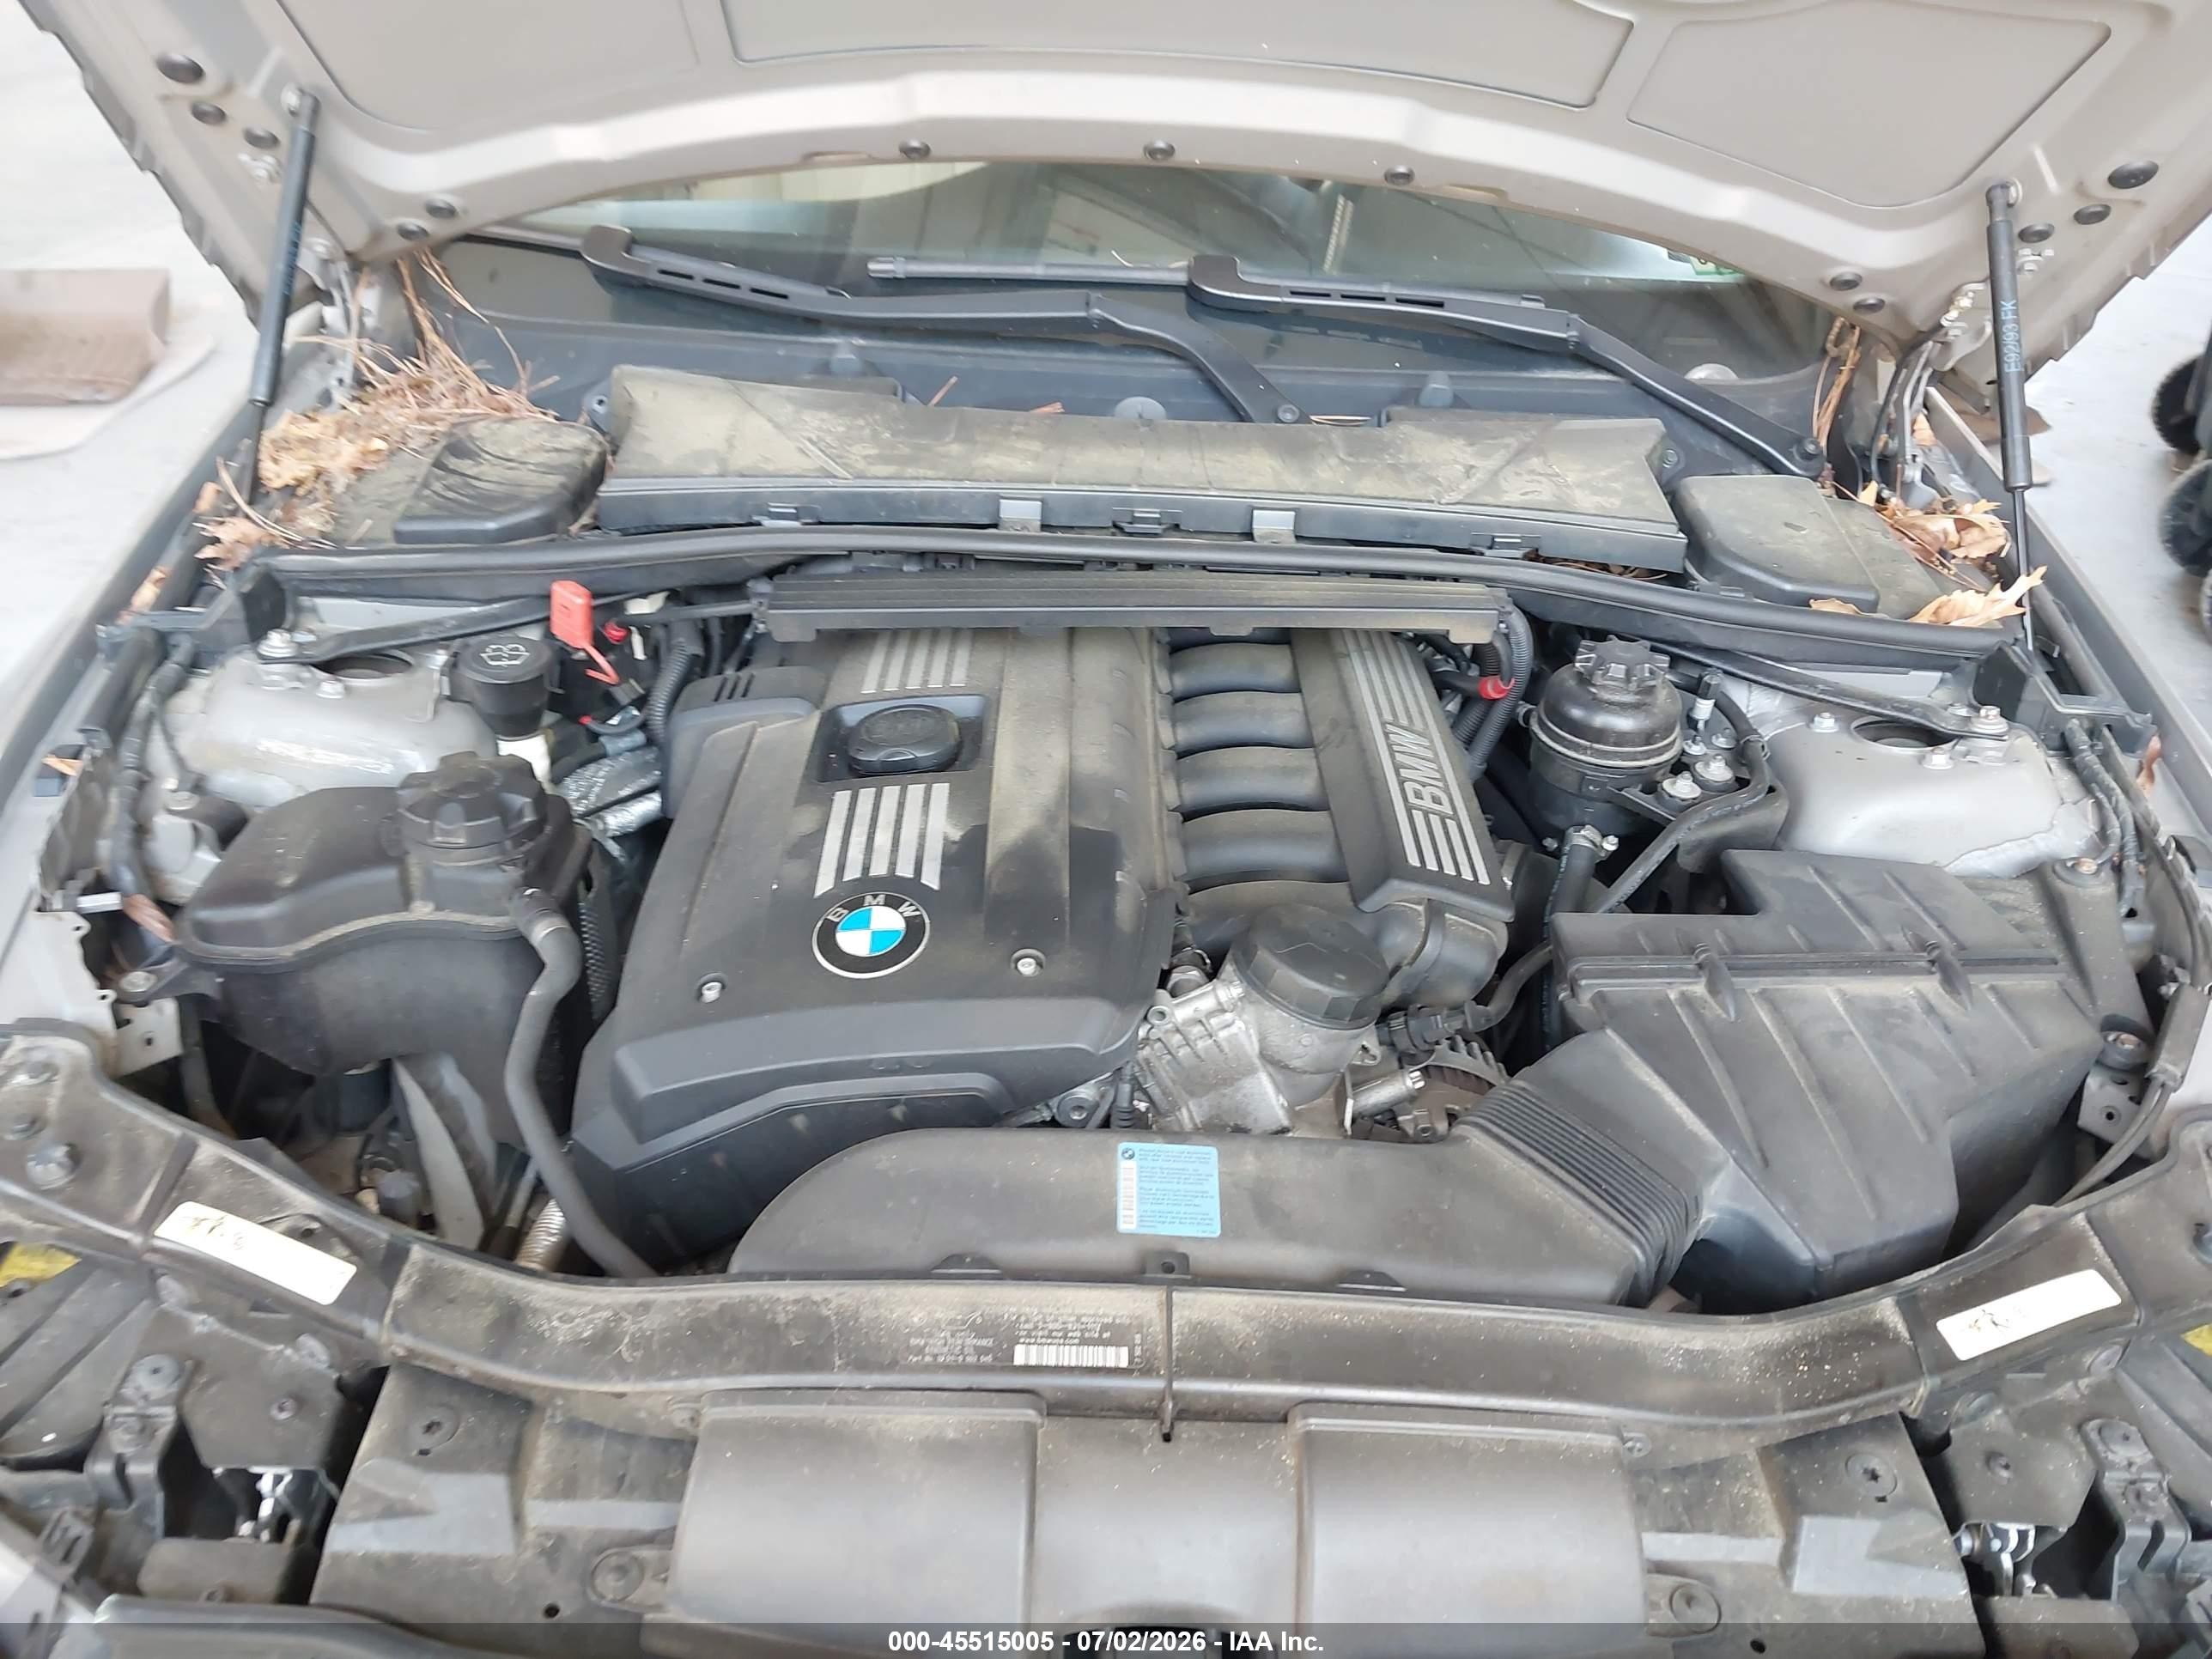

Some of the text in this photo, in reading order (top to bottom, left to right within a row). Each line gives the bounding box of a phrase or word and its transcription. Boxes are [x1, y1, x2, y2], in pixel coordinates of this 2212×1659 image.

[1999, 299, 2021, 373] E92/93 FK
[1386, 723, 1454, 815] BMW
[826, 894, 921, 922] BMW
